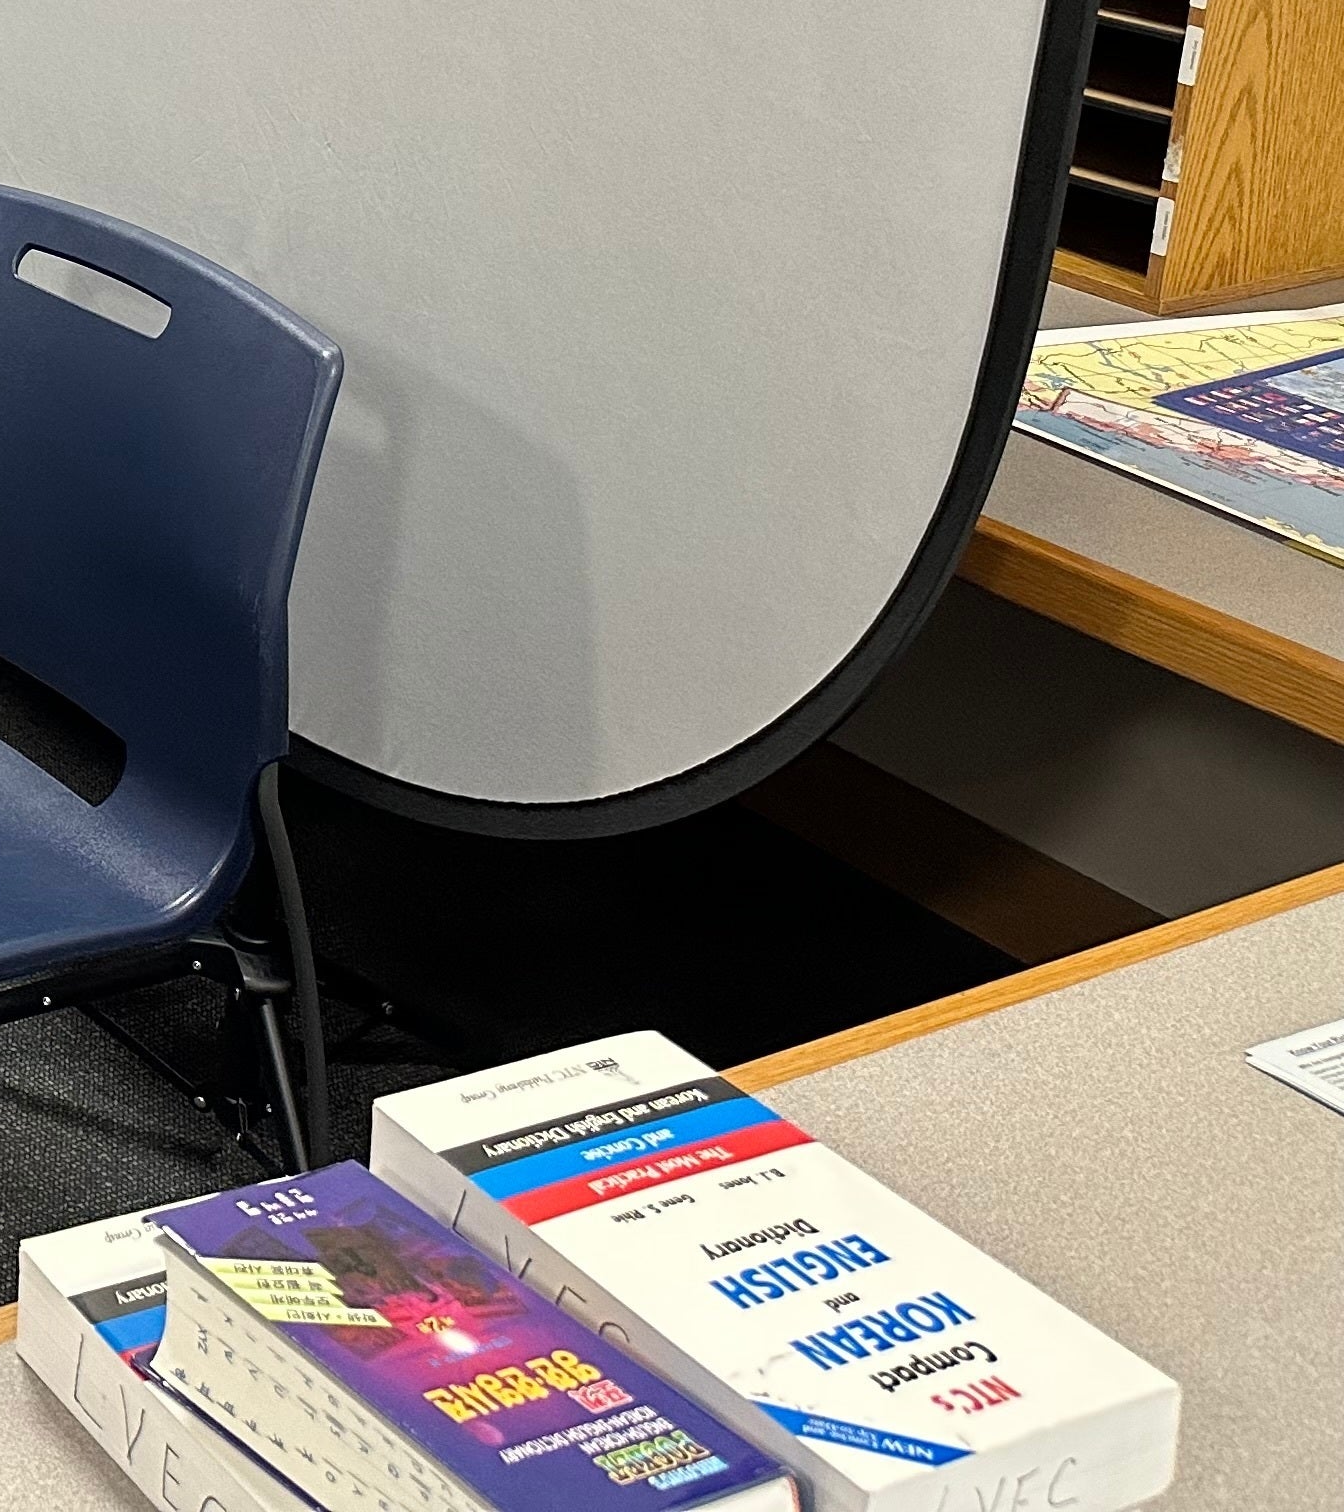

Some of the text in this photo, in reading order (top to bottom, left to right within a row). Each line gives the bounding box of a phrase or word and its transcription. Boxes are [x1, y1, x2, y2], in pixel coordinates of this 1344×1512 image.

[482, 1088, 709, 1159] Korean and English Dictionary
[580, 1127, 675, 1163] and Concise
[587, 1143, 735, 1197] The Most Practical
[718, 1174, 759, 1191] Jones
[645, 1203, 662, 1215] S.
[662, 1193, 697, 1209] Gene
[698, 1217, 821, 1261] Dictionary
[708, 1234, 893, 1310] ENGLISH
[823, 1291, 862, 1313] and
[789, 1291, 977, 1372] KOREAN
[868, 1340, 999, 1394] Compact
[930, 1375, 1023, 1415] NTC's
[498, 1431, 568, 1467] DICTIONARY
[591, 1430, 712, 1486] POCKET
[881, 1436, 935, 1461] NEW
